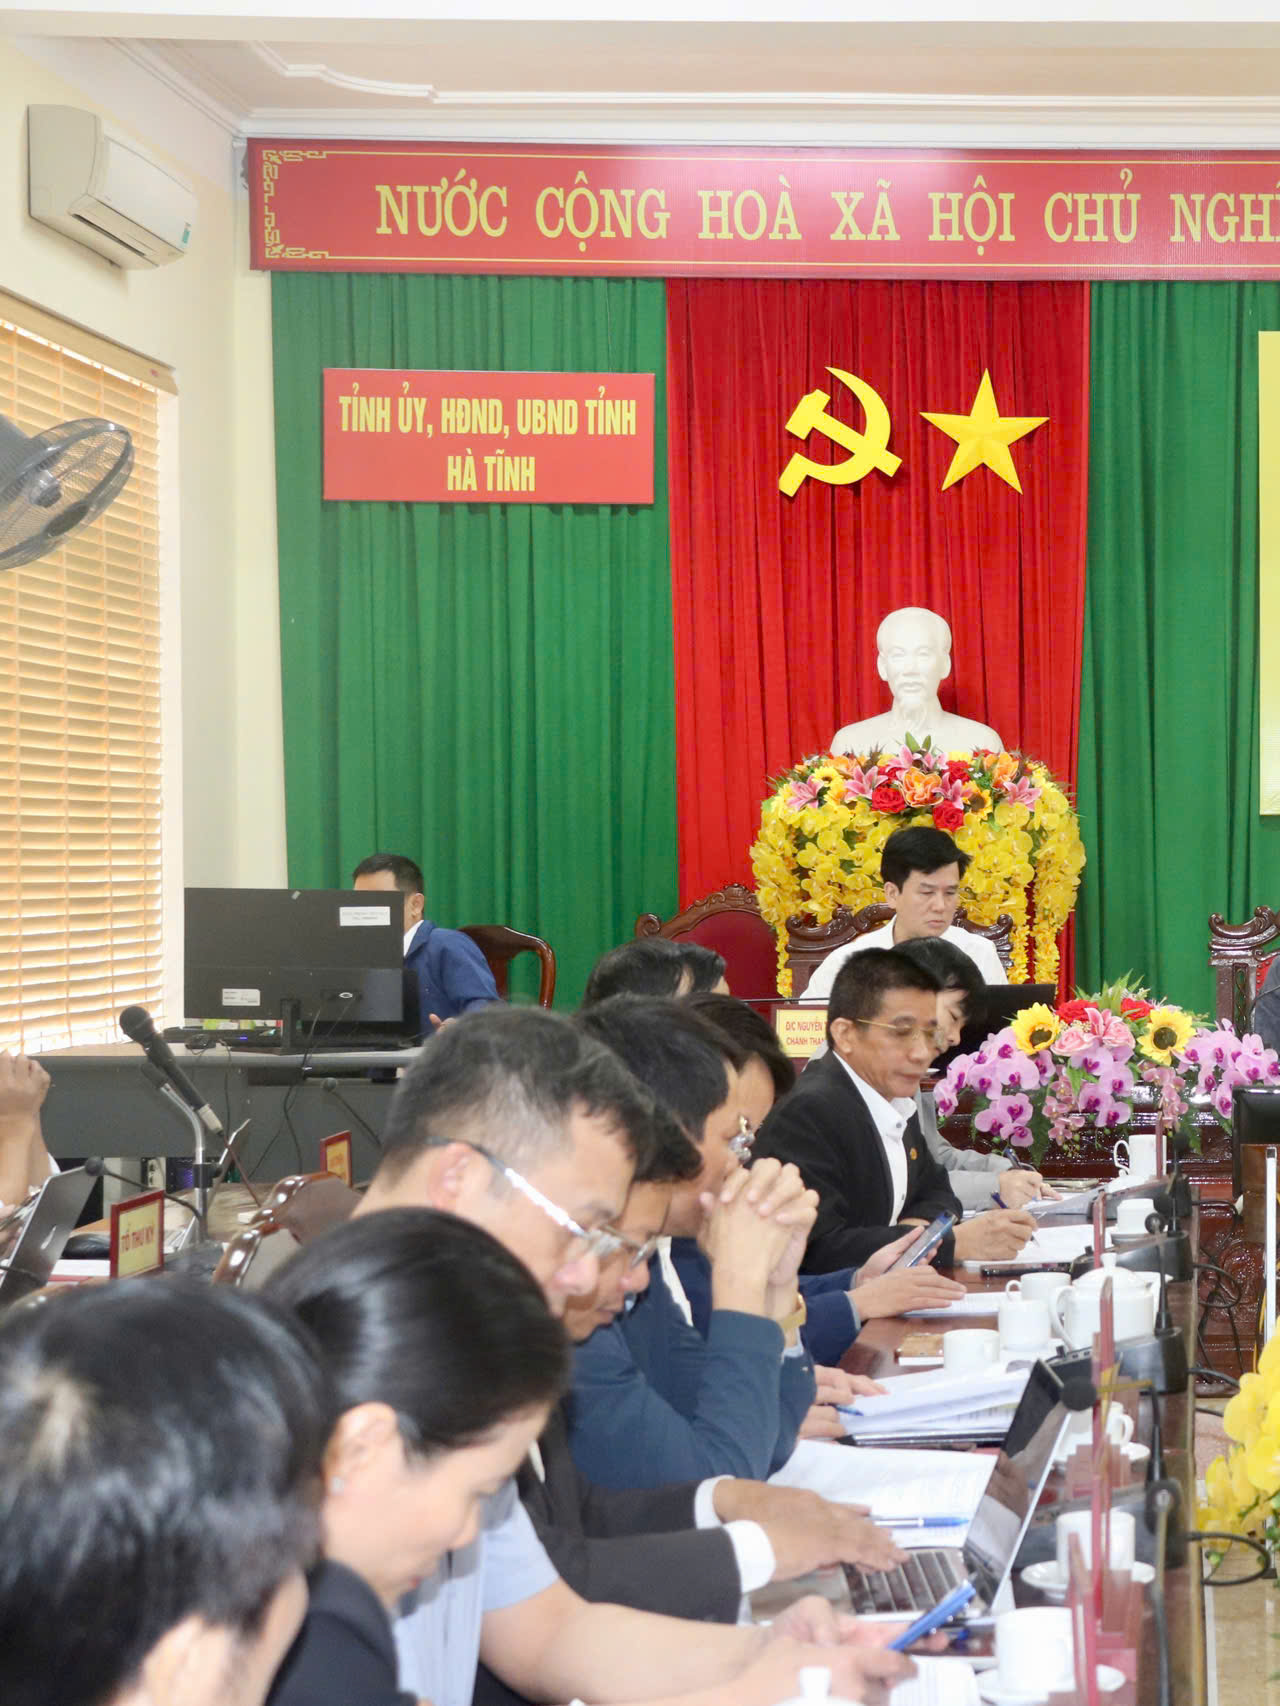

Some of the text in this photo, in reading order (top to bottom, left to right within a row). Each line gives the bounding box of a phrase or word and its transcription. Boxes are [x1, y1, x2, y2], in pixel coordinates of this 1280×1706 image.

[376, 169, 508, 237] NƯỚC
[536, 172, 672, 252] CỘNG
[699, 182, 802, 241] HOÀ
[832, 180, 900, 241] XÃ
[928, 176, 1016, 256] HỘI
[1045, 168, 1140, 243] CHỦ
[339, 381, 637, 439] TỈNH ỦY, HĐND, UBND TỈNH
[447, 447, 536, 491] HÀ TĨNH
